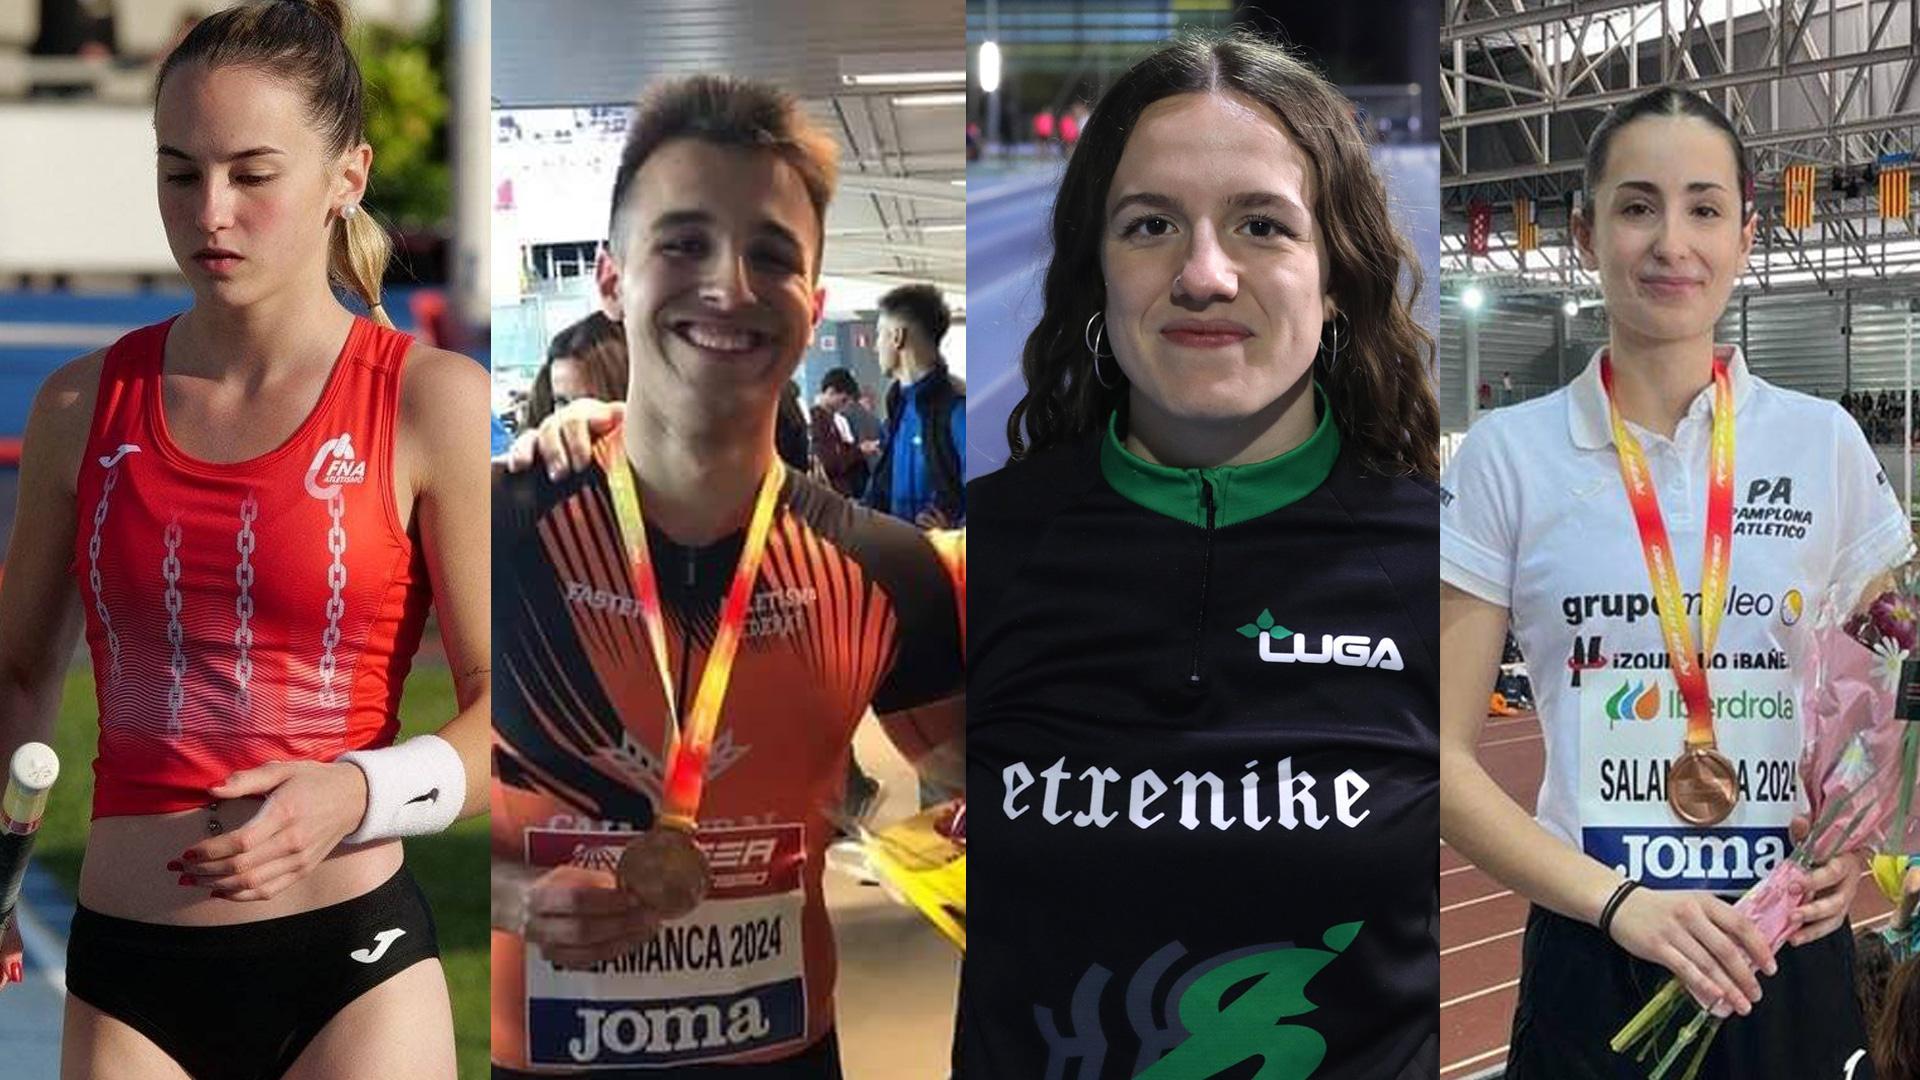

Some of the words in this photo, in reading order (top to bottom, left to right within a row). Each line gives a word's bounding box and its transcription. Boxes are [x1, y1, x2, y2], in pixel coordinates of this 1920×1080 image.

[326, 459, 366, 477] FNA
[1747, 477, 1793, 505] PA
[1259, 632, 1405, 671] LUGA
[1002, 756, 1371, 831] etxenike
[1600, 759, 1751, 802] SALAA
[1756, 760, 1797, 802] 2024
[552, 923, 724, 975] AMANCA
[729, 915, 782, 969] 2024
[568, 997, 770, 1063] Joma
